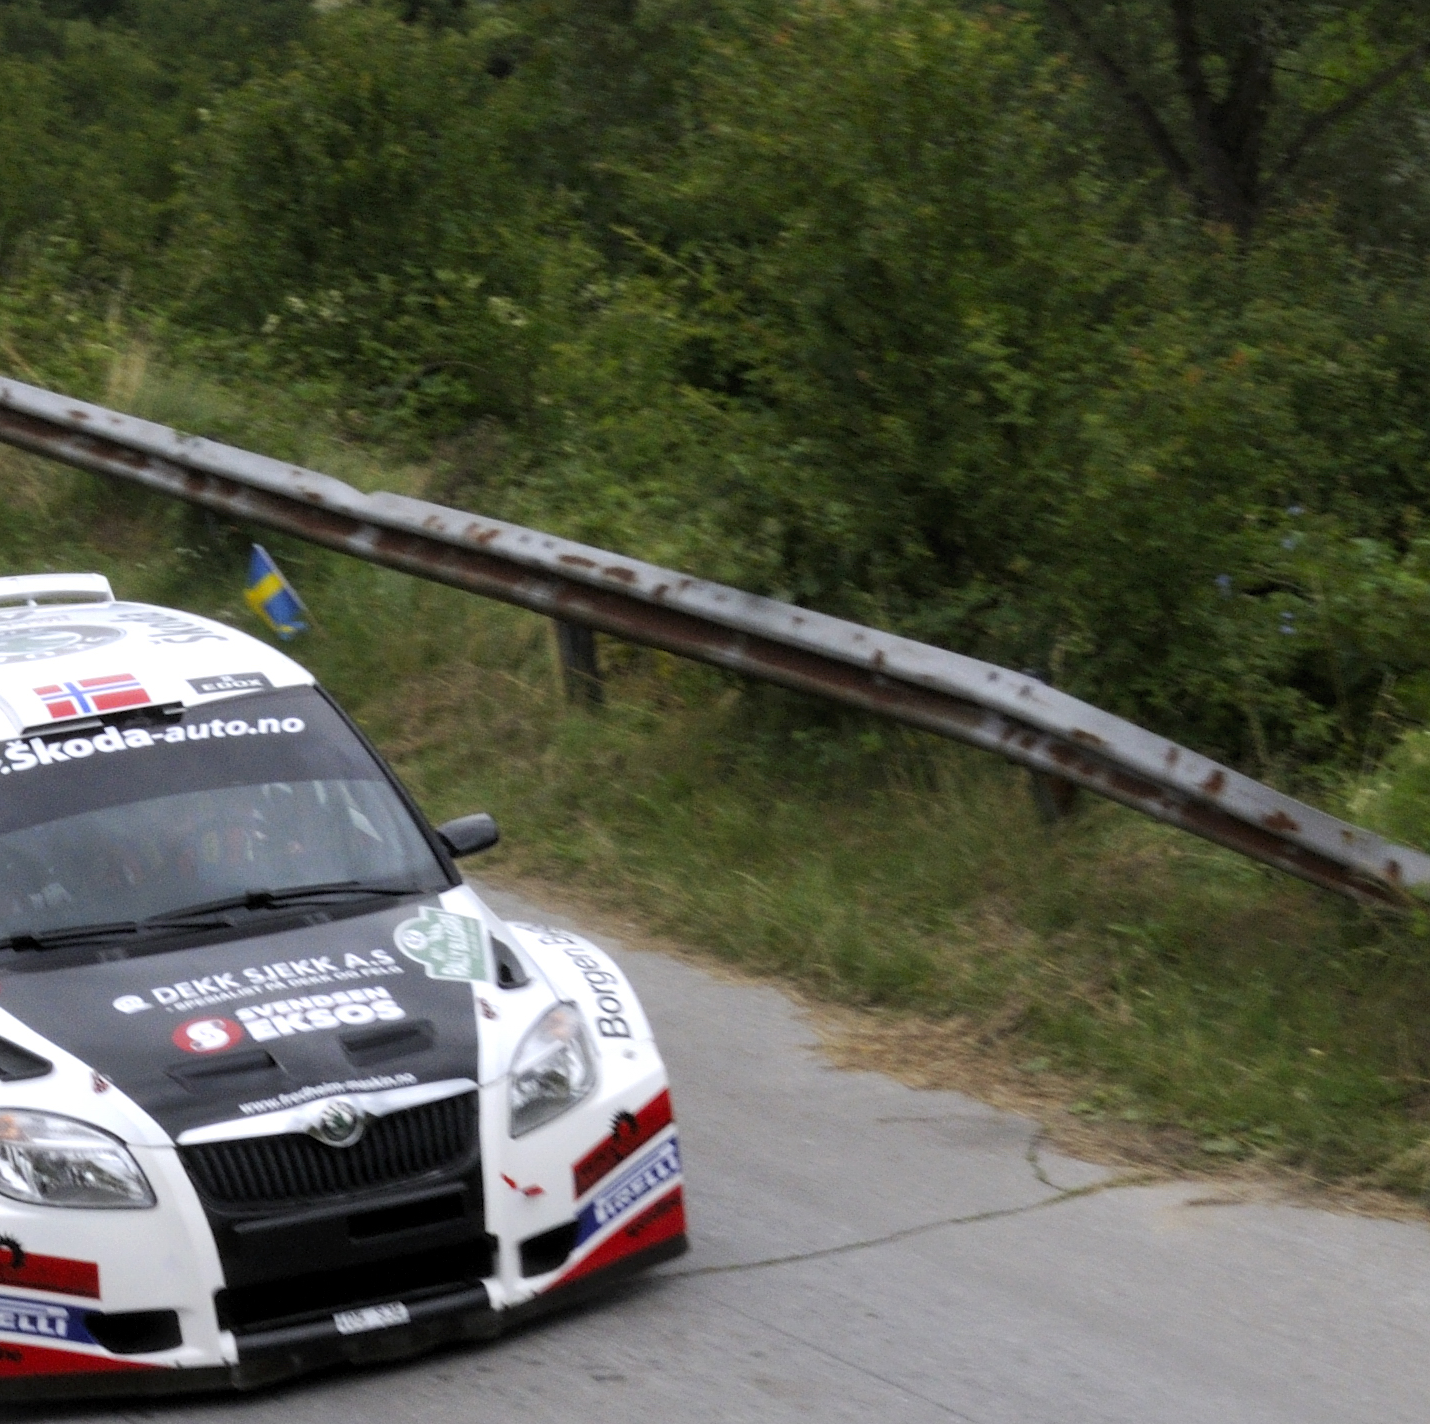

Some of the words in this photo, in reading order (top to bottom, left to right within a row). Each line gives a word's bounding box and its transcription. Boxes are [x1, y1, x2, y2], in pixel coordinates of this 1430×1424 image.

[200, 678, 263, 692] EDOX
[151, 971, 242, 1005] DEKK
[242, 955, 340, 985] SJEKK
[235, 985, 394, 1021] SVENDSEN
[562, 948, 632, 1039] Borgen
[243, 1000, 406, 1043] EKSOS
[592, 1140, 681, 1224] PIRELLI
